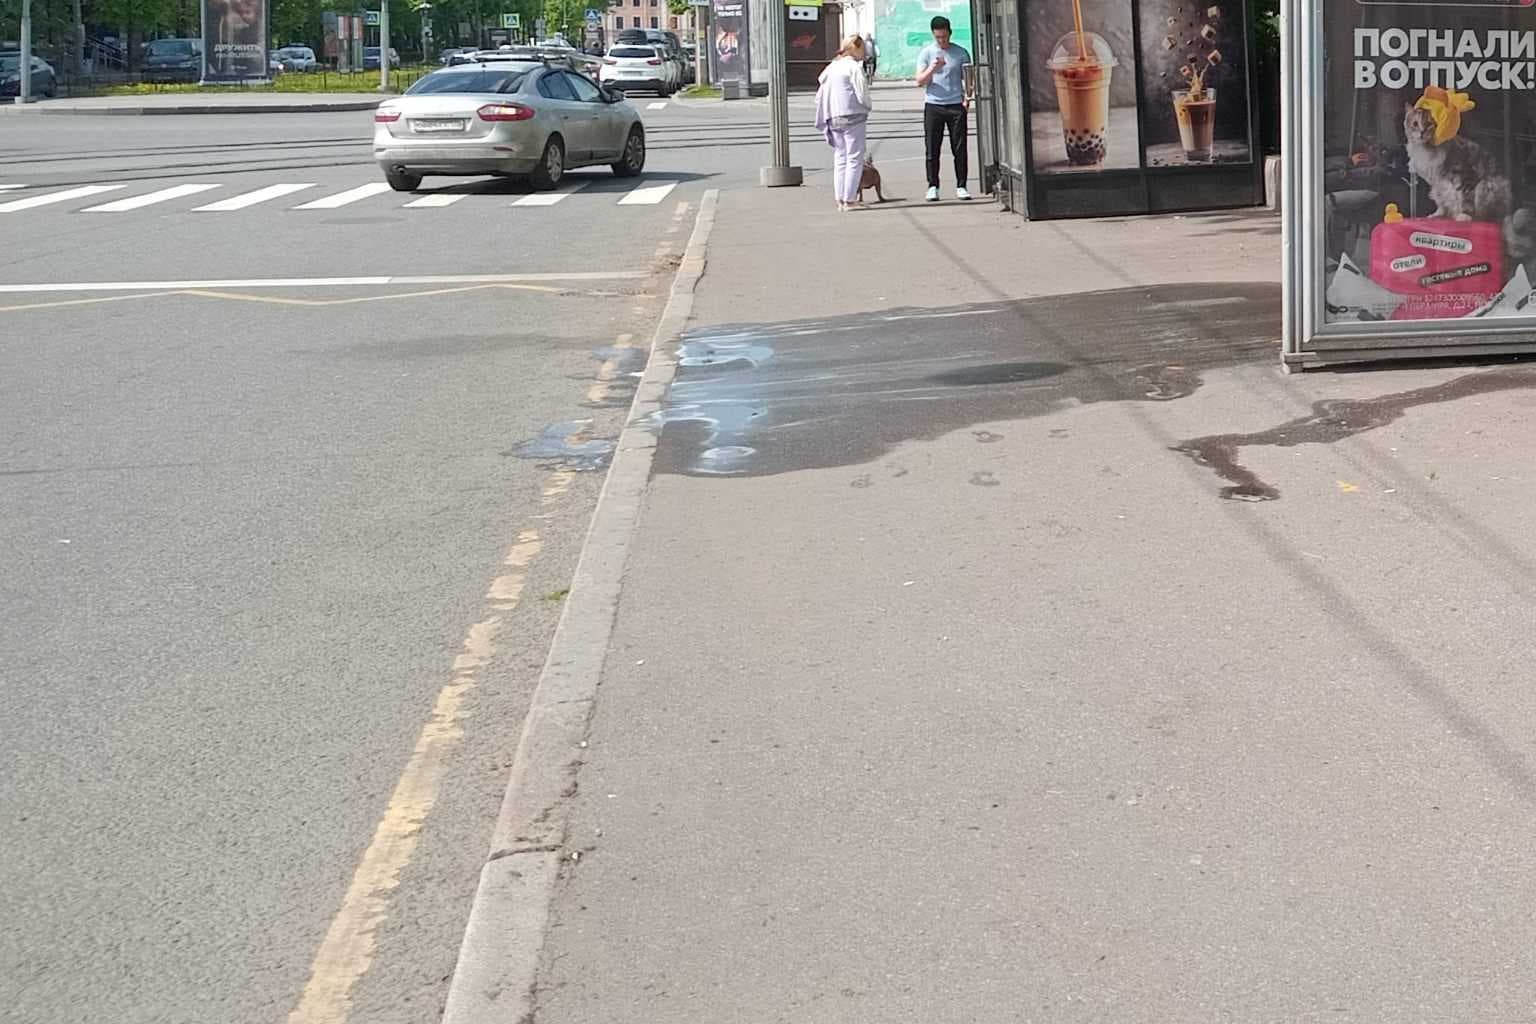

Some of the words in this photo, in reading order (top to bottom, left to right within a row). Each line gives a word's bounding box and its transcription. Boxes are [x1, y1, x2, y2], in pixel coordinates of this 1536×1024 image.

[1354, 27, 1536, 59] ПОГНАЛИ
[1354, 60, 1377, 89] В
[1380, 59, 1536, 90] ОТПУСК!
[1415, 236, 1466, 250] квартиры
[1392, 257, 1423, 270] отели
[1464, 264, 1488, 277] дома
